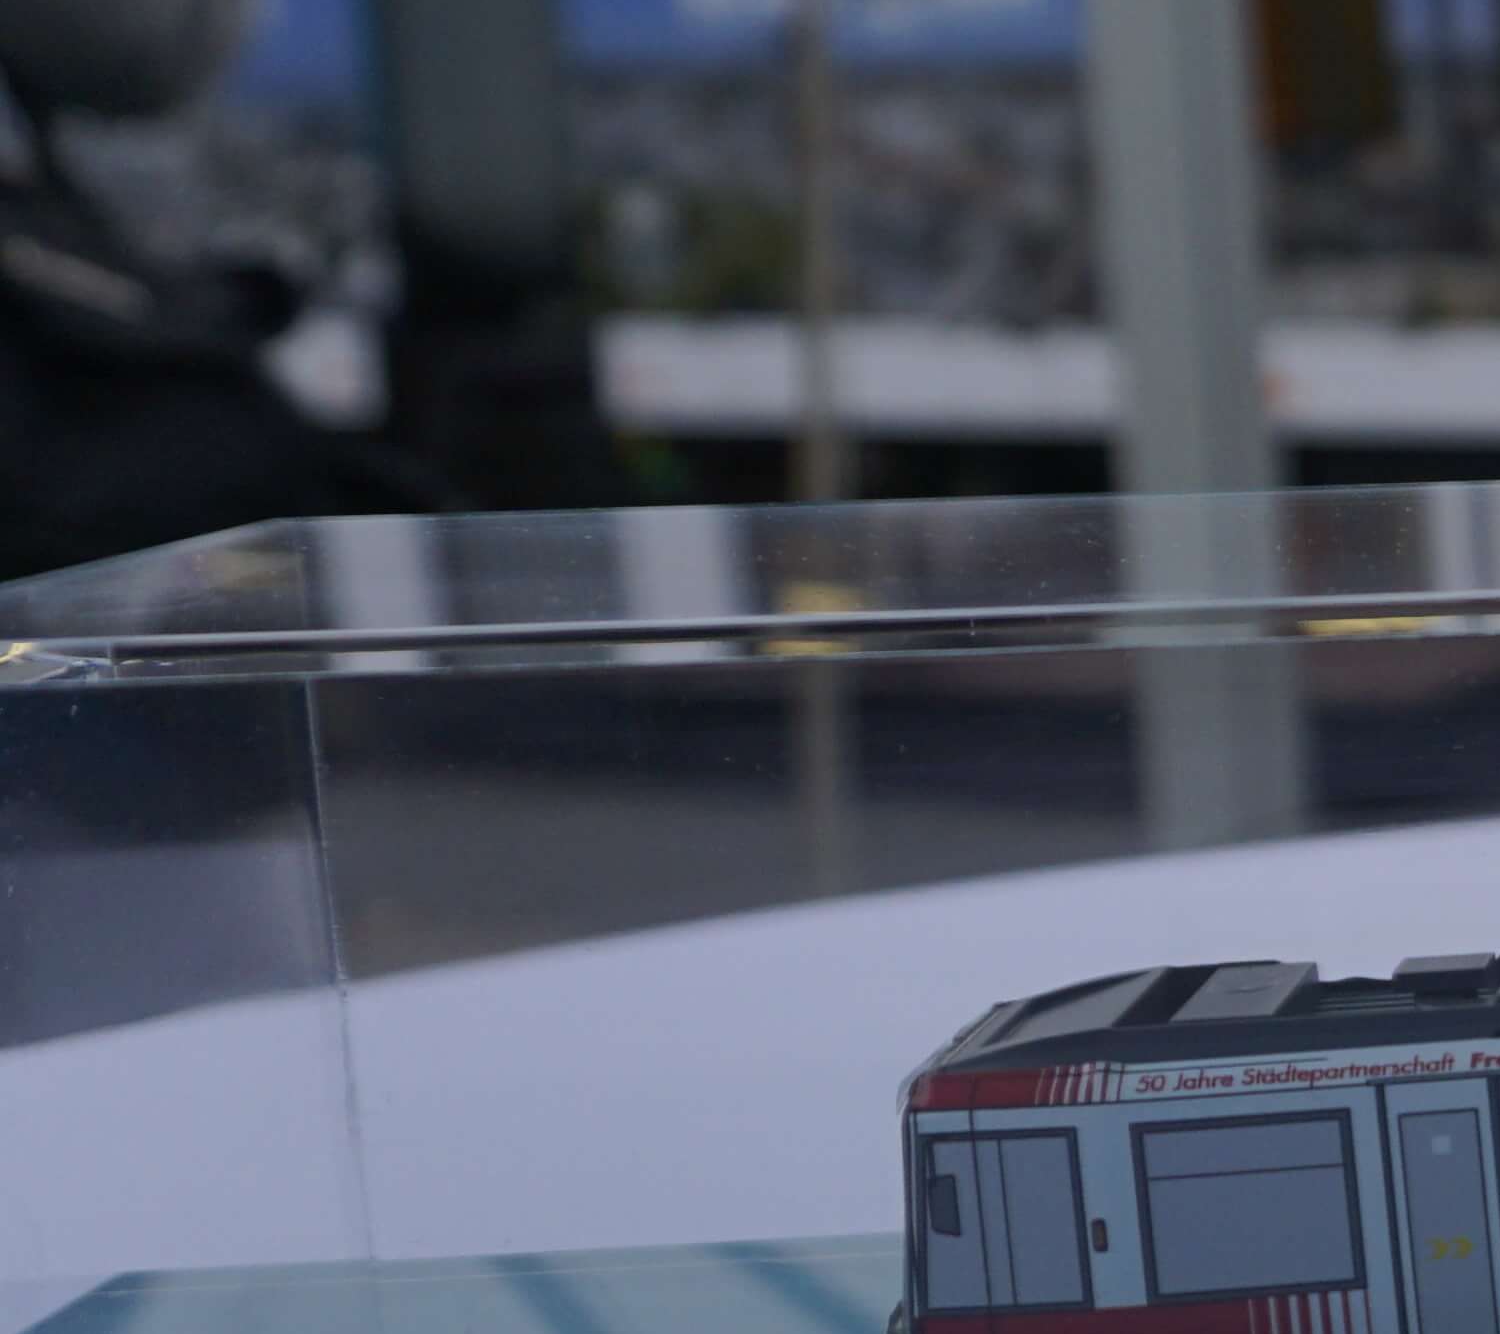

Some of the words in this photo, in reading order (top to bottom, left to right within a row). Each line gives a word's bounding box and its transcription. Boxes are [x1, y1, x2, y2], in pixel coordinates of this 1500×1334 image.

[1135, 1073, 1166, 1094] 50
[1172, 1068, 1234, 1091] Jahre
[1242, 1054, 1456, 1085] Städtepartnerschaft
